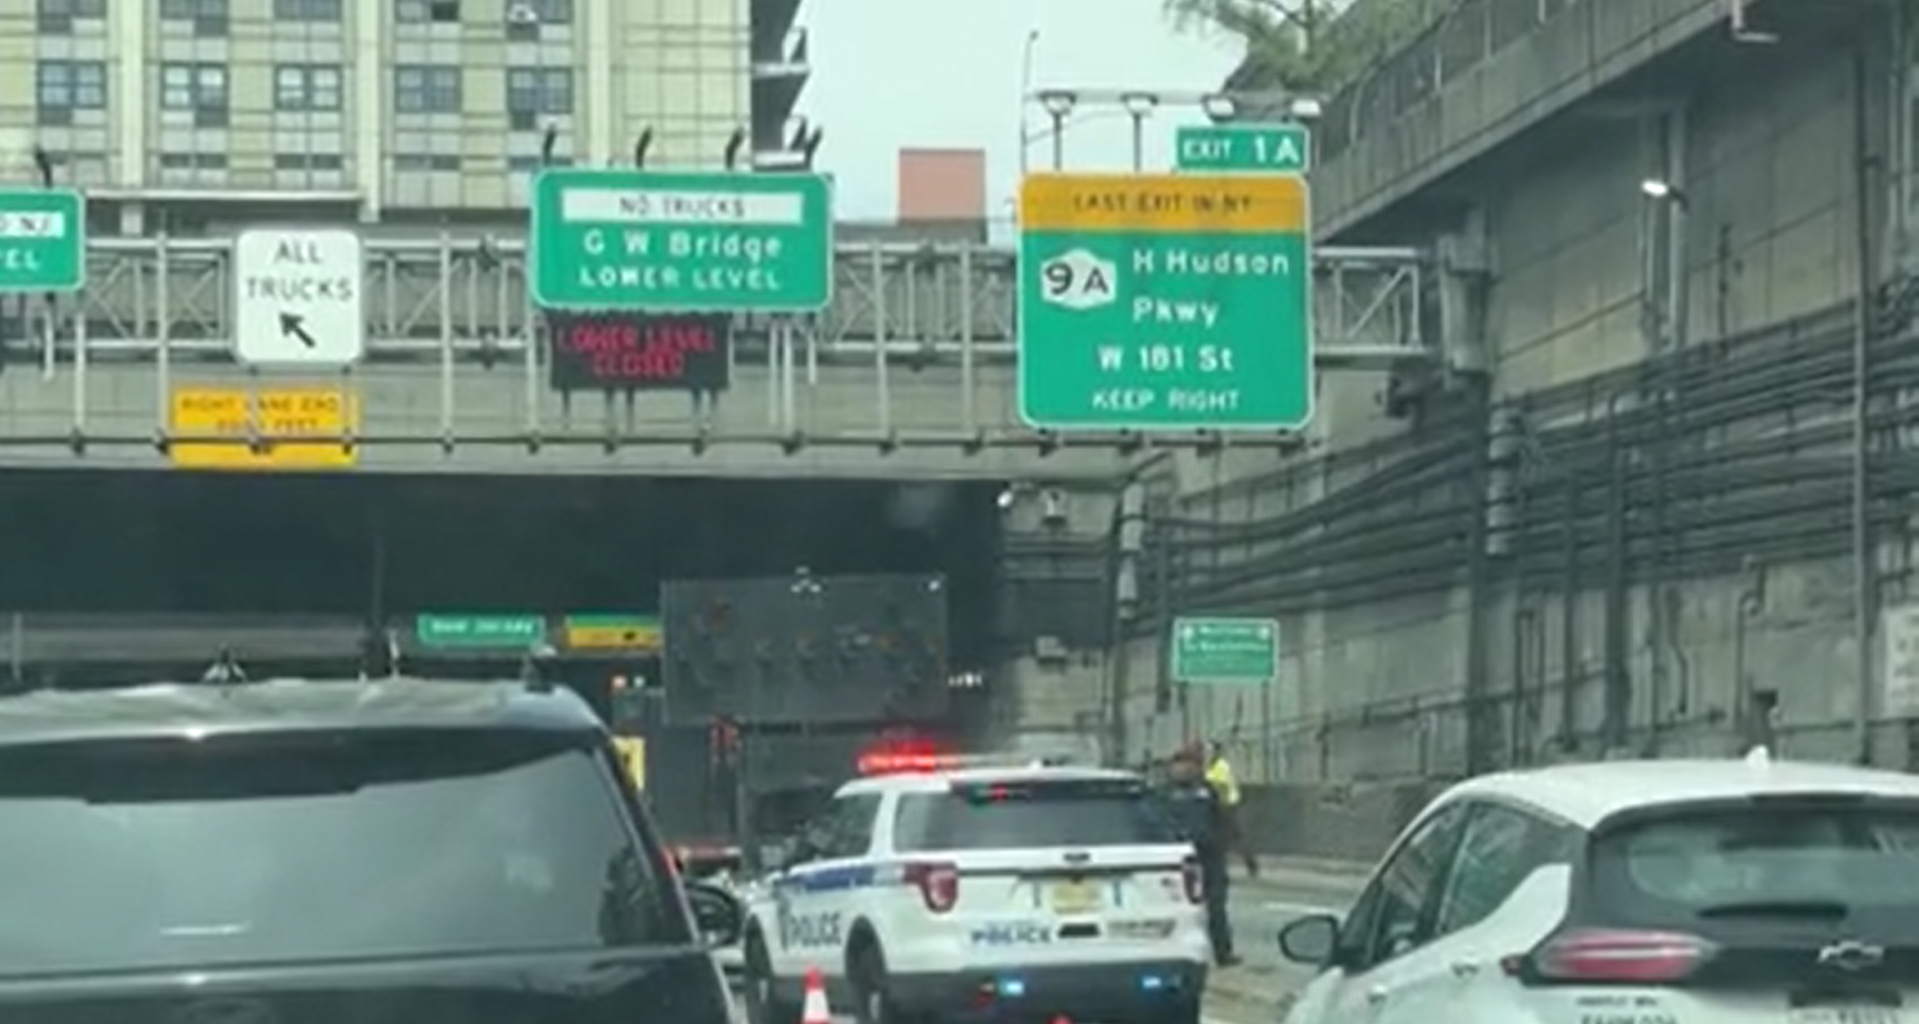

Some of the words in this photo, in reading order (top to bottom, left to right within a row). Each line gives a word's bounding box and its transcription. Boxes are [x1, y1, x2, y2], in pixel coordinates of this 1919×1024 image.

[1184, 138, 1231, 158] EXIT
[1254, 136, 1300, 163] 1A
[620, 194, 651, 216] NO
[662, 196, 745, 218] TRUCKS
[1073, 193, 1127, 212] LAST
[1138, 192, 1182, 212] EXIT
[274, 240, 322, 264] ALL
[584, 229, 605, 254] G
[624, 230, 649, 254] W
[669, 231, 781, 263] Bridge
[1133, 249, 1154, 273] H
[1167, 250, 1290, 274] Hudson
[247, 276, 353, 302] TRUCKS
[580, 266, 680, 288] LOWER
[693, 267, 781, 291] LEVEL
[1133, 296, 1218, 327] Pkwy
[557, 324, 639, 351] LOWER
[592, 351, 684, 378] CLOSED
[1099, 345, 1124, 371] W
[1139, 345, 1185, 371] 181
[1199, 345, 1234, 372] St
[1092, 389, 1154, 410] KEEP
[1168, 388, 1239, 411] RIGHT
[786, 911, 842, 948] POLICE
[971, 925, 1051, 945] POLICE
